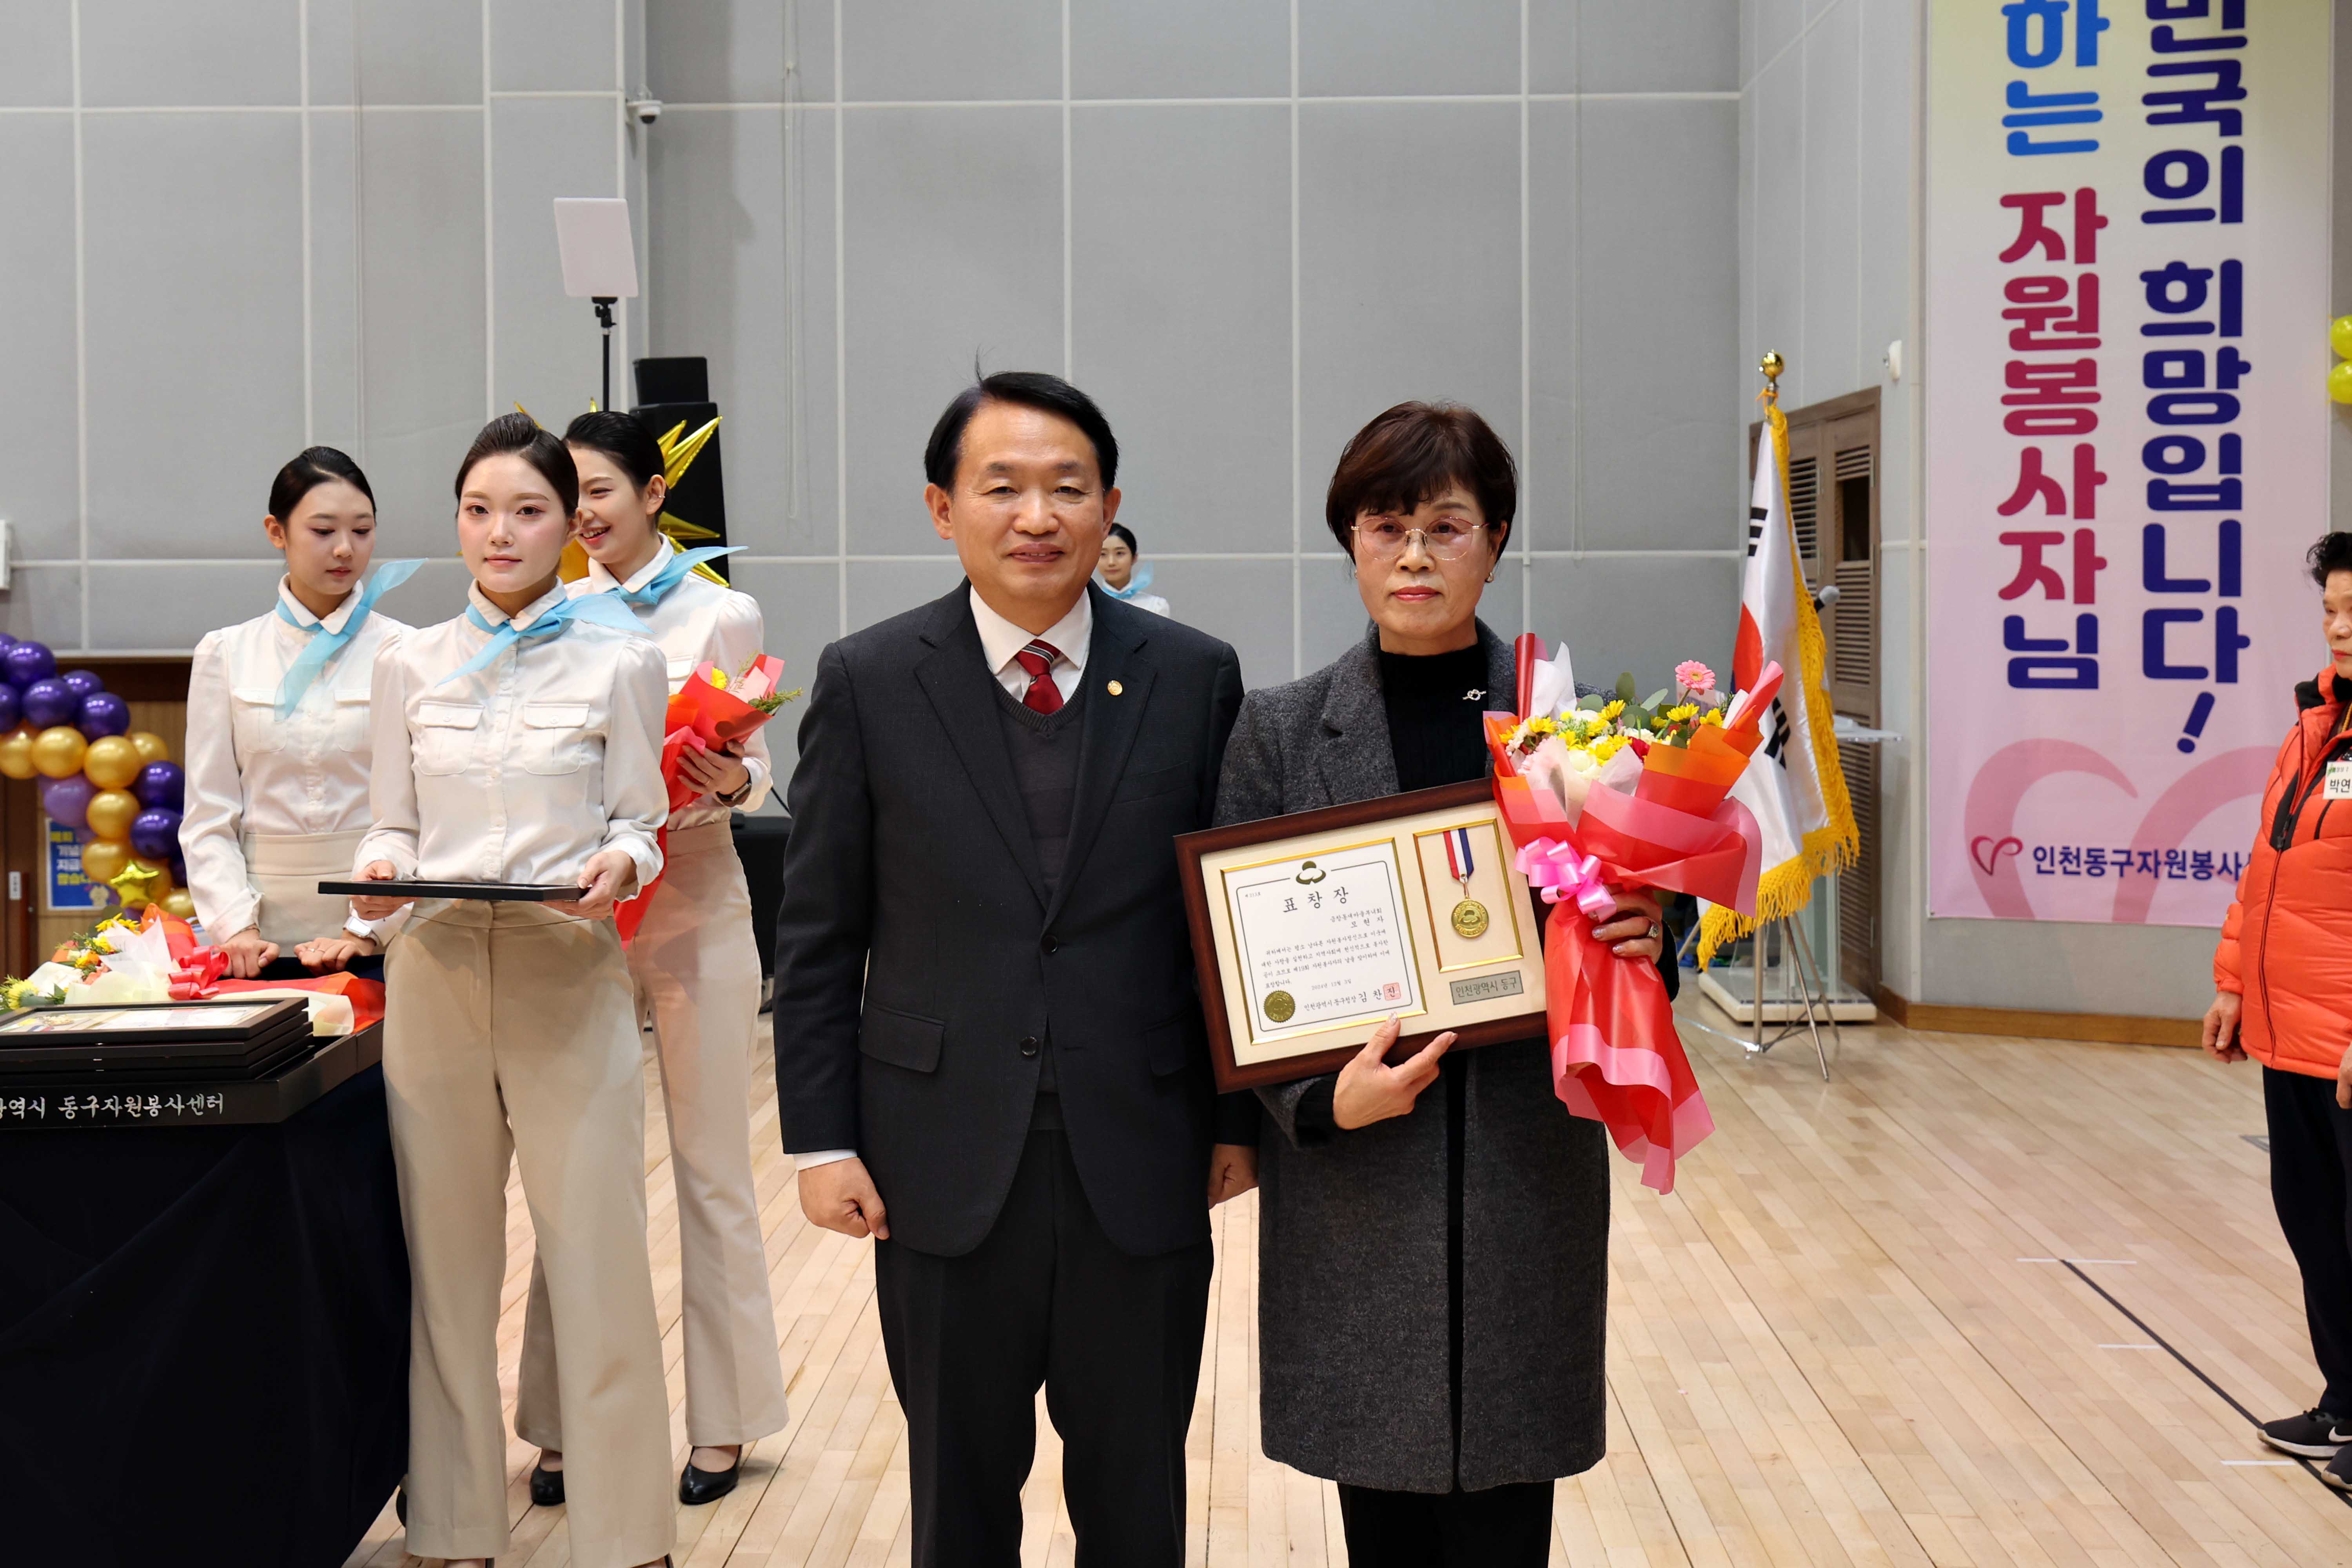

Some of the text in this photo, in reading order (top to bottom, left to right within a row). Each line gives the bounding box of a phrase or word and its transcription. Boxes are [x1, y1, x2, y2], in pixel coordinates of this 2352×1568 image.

[1997, 0, 2110, 689] 하는 자원봉사자님
[2139, 258, 2251, 754] 희망입니다!
[2330, 779, 2352, 793] 박연
[2033, 846, 2251, 881] 인천동구자원봉사
[1283, 886, 1348, 913] 표 창 장
[1304, 1000, 1332, 1011] 인천광역시
[1333, 995, 1356, 1006] 동구청장
[1358, 991, 1367, 1003] 김
[1373, 989, 1382, 1000] 찬
[1455, 976, 1517, 997] 인천광역시 동구
[58, 1093, 224, 1120] 동구자원봉사센터
